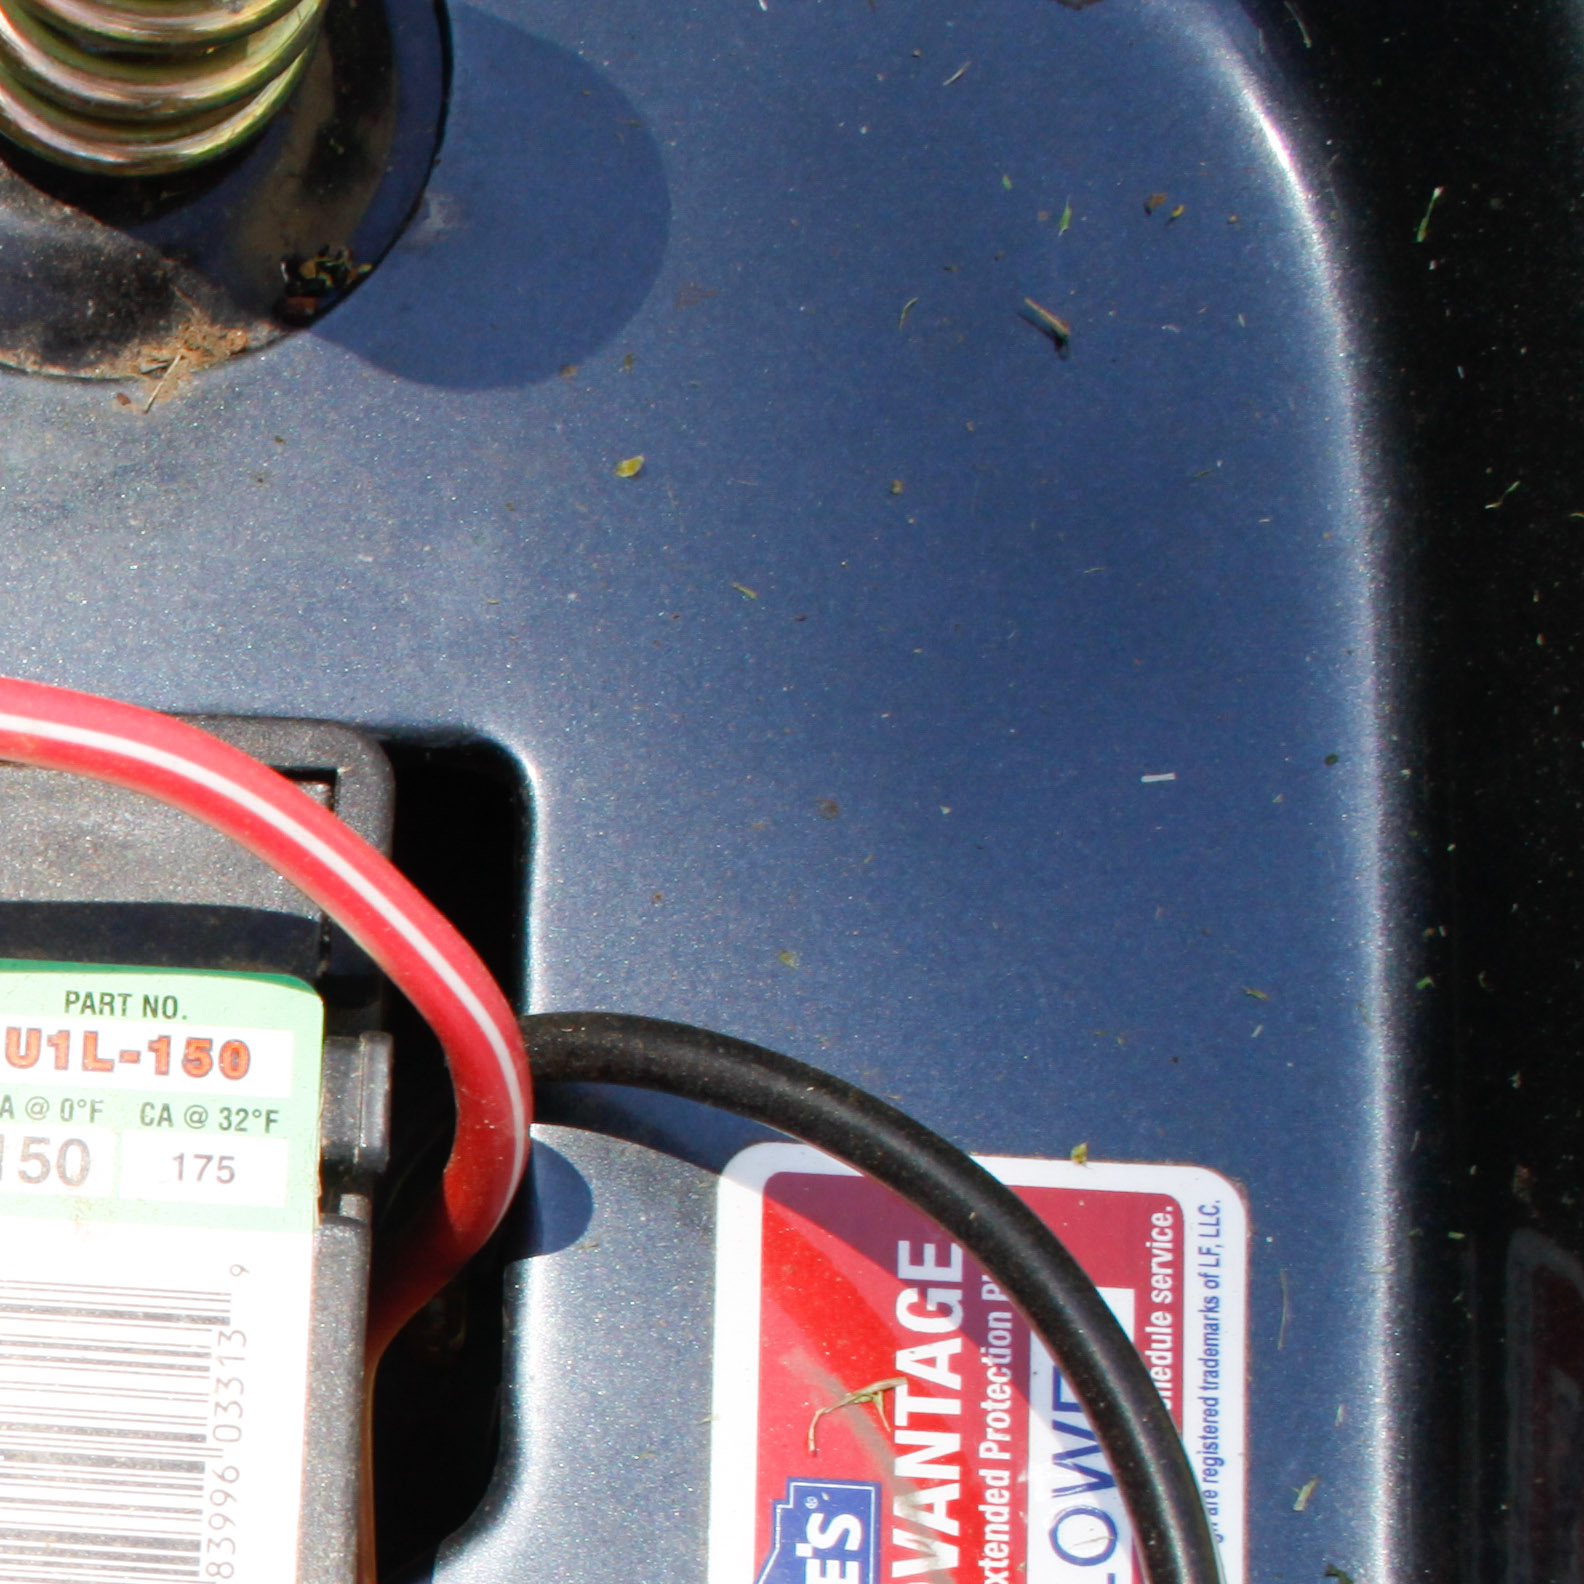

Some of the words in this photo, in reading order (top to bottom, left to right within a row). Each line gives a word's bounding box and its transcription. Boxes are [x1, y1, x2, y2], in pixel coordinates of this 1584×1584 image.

[63, 990, 133, 1017] PART
[142, 994, 188, 1021] NO.
[4, 1027, 251, 1081] U1L-150
[140, 1102, 173, 1128] CA
[172, 1153, 236, 1184] 175
[1197, 1199, 1221, 1237] LLC.
[1145, 1205, 1173, 1303] service.
[1197, 1243, 1224, 1267] LF,
[1197, 1271, 1221, 1288] of
[1197, 1294, 1221, 1390] trademarks
[212, 1329, 247, 1443] 03313
[979, 1310, 1012, 1459] Protection
[1196, 1395, 1225, 1483] registered
[205, 1465, 240, 1580] 83996
